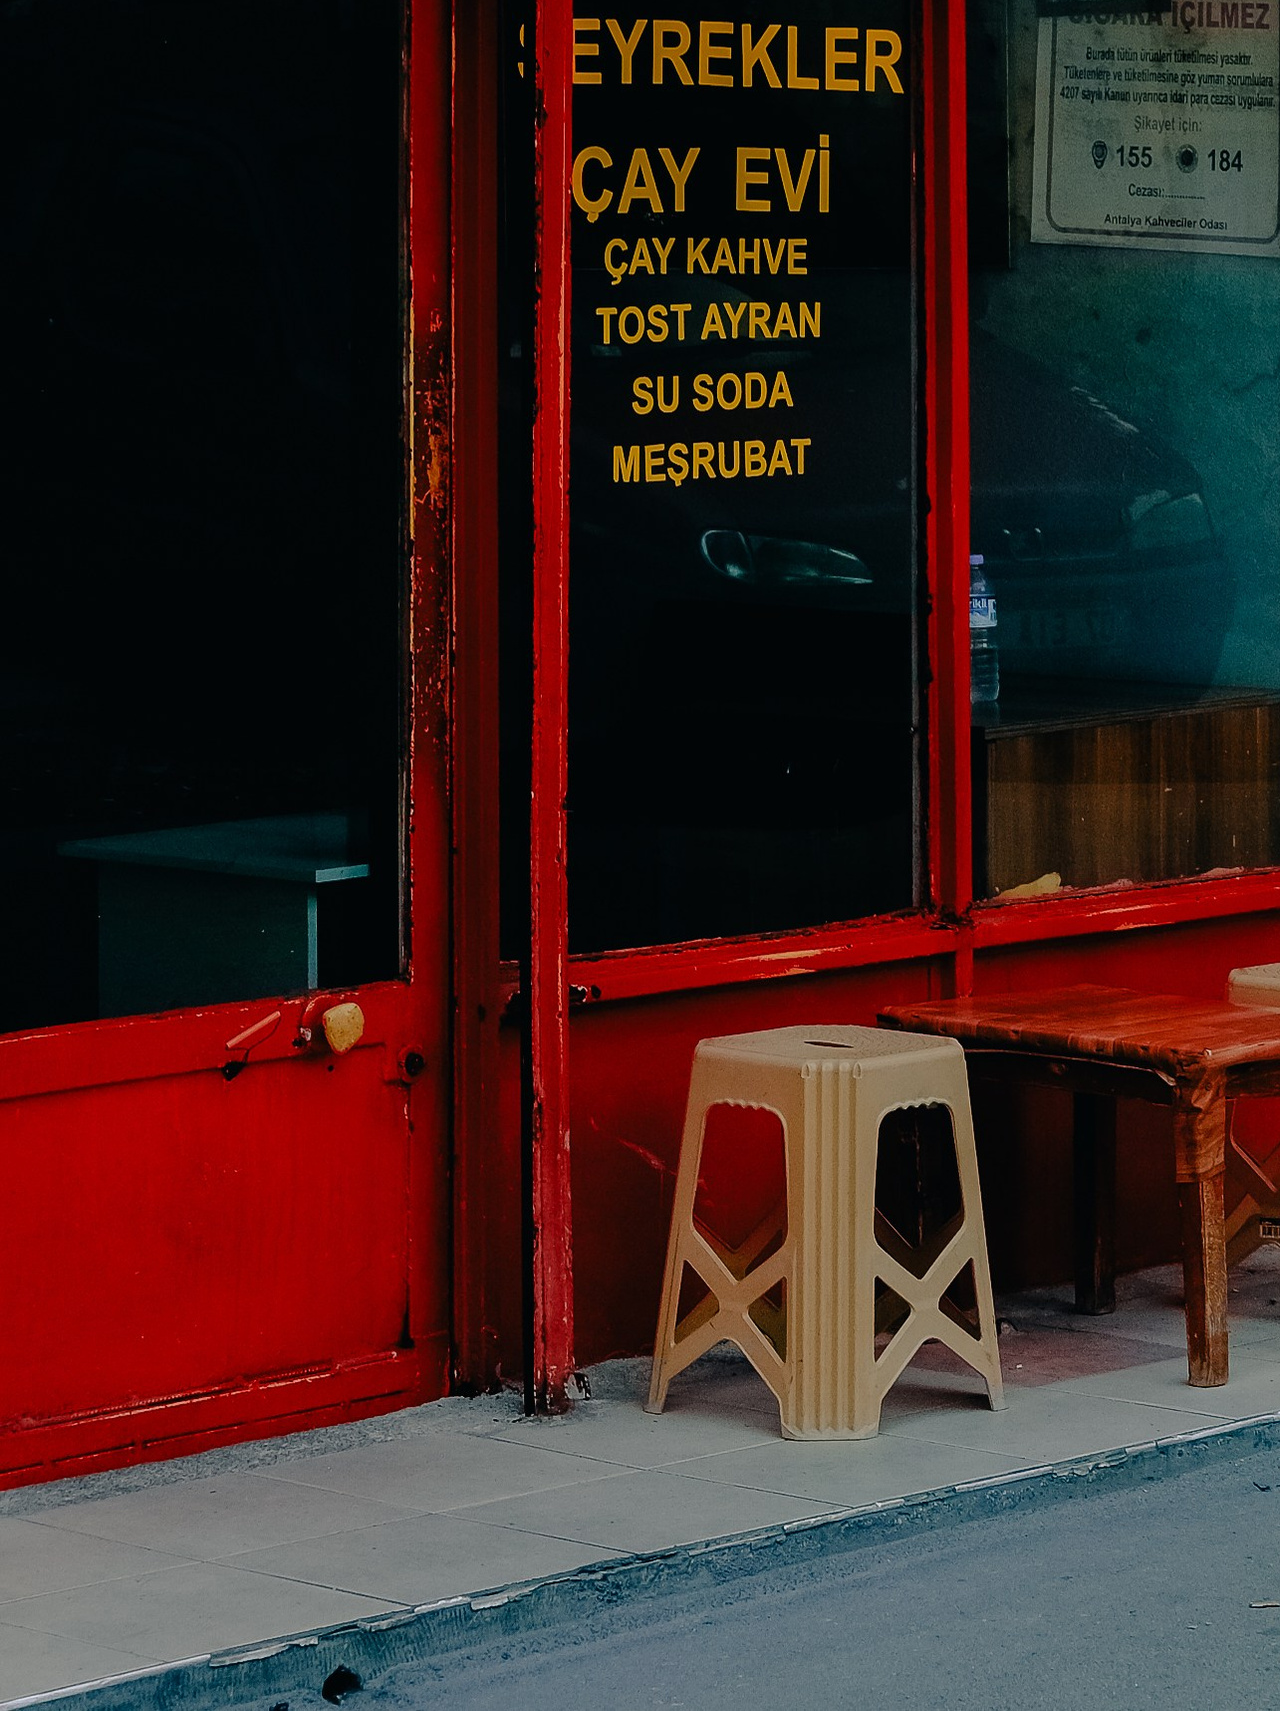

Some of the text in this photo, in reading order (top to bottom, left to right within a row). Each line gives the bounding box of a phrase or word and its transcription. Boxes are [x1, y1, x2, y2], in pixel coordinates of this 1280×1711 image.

[517, 18, 904, 94] EYREKLER
[1086, 47, 1115, 61] Burada
[1174, 49, 1218, 65] tüketilmesi
[1113, 70, 1122, 82] ve
[1180, 71, 1196, 87] göz
[1197, 73, 1225, 88] yuman
[1226, 73, 1273, 88] sorumlulara
[1060, 86, 1080, 100] 4207
[1104, 89, 1131, 101] Kanun
[1190, 93, 1208, 107] para
[1210, 93, 1236, 106] cezası
[1134, 115, 1202, 134] Şikayet için:
[1116, 145, 1152, 168] 155
[1207, 149, 1243, 172] 184
[572, 133, 830, 223] ÇAY EVİ
[1104, 213, 1228, 231] Antalya Kahveciler Odası
[604, 238, 809, 286] ÇAY KAHVE
[596, 301, 821, 344] TOST AYRAN
[632, 371, 794, 415] SU SODA
[613, 438, 812, 487] MEŞRUBAT
